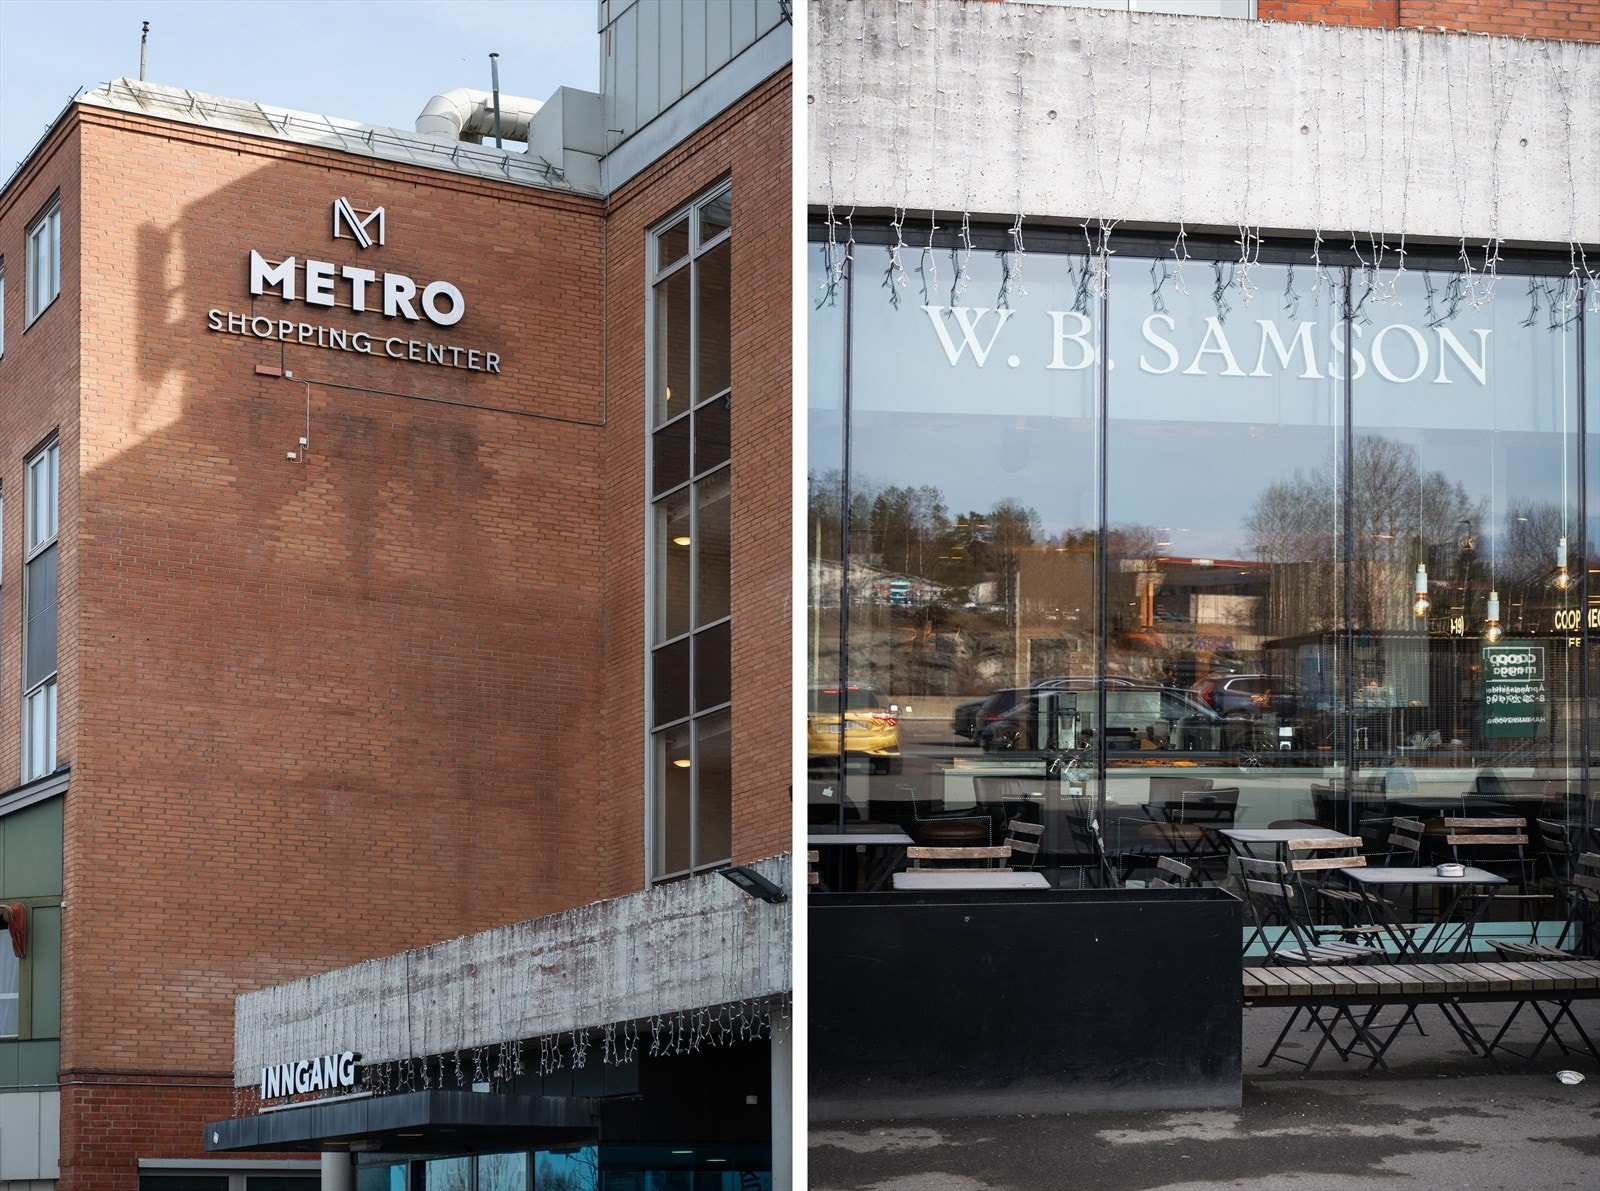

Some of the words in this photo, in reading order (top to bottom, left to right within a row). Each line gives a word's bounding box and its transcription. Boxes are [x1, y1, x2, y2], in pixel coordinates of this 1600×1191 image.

[249, 249, 466, 327] METRO
[207, 308, 372, 353] SHOPPING
[385, 337, 501, 374] CENTER
[920, 304, 1021, 368] W.
[1139, 313, 1494, 386] SAMSON
[261, 1050, 357, 1101] INNGANG
